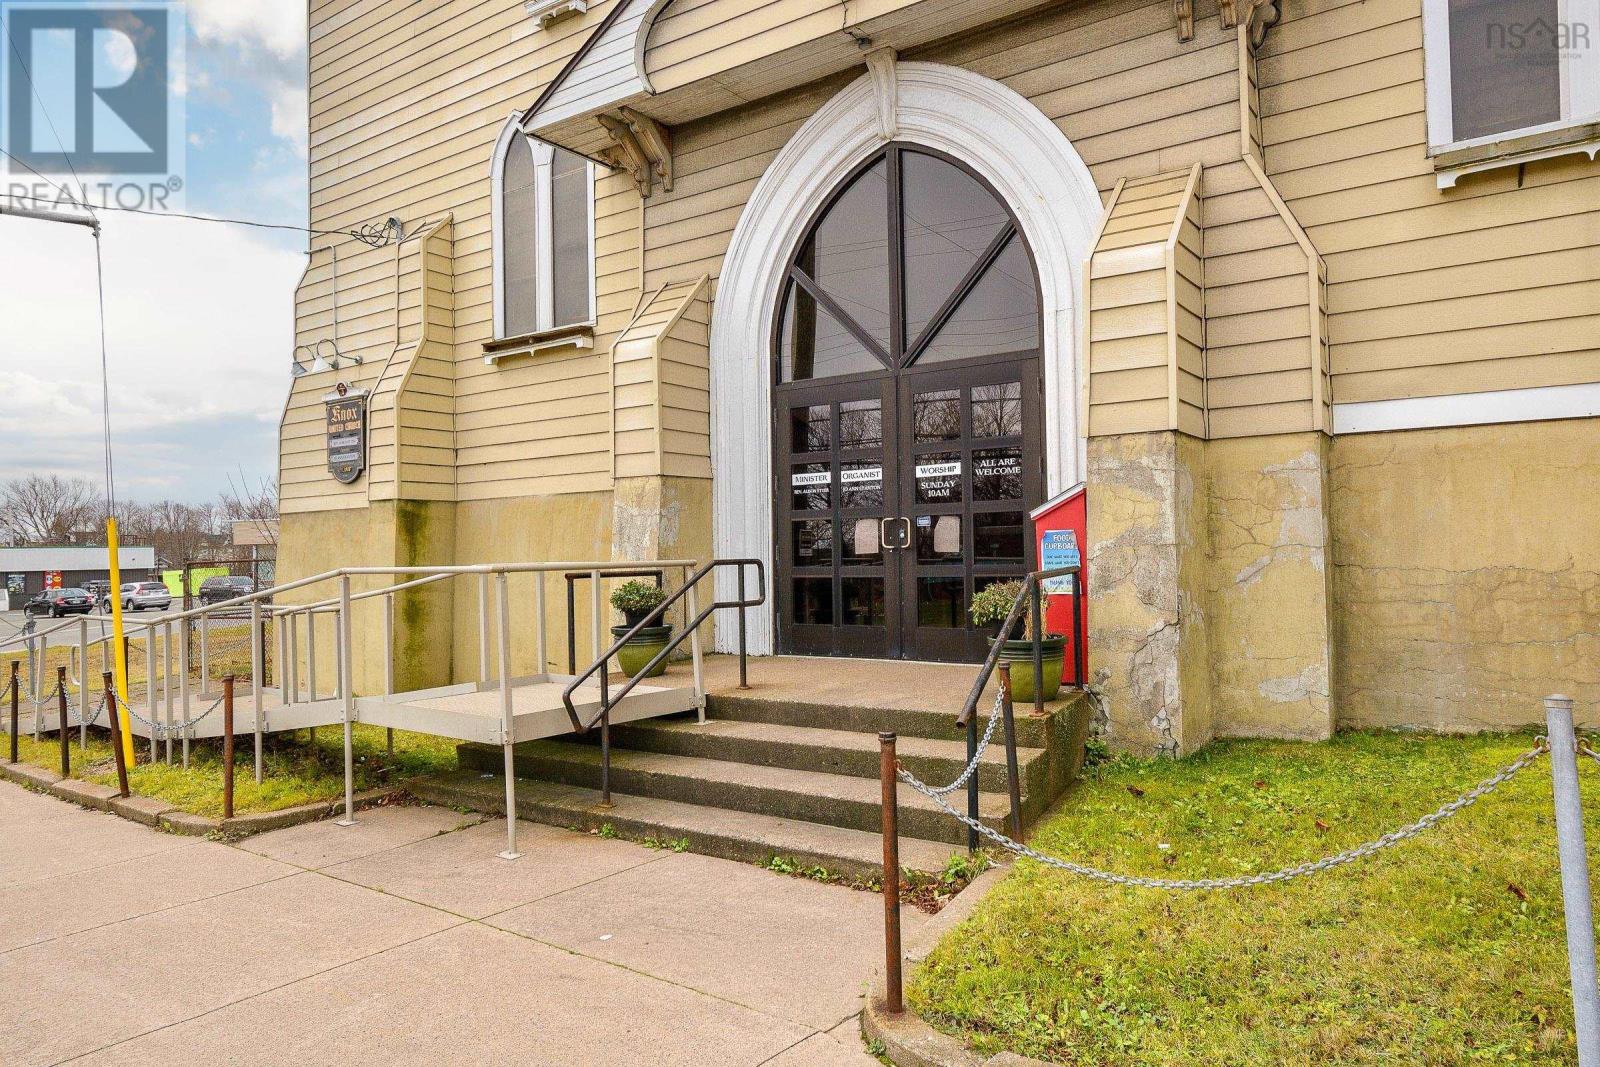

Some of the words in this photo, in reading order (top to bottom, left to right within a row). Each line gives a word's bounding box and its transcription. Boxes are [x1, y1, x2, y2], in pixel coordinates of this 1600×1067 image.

[331, 405, 358, 423] Knox
[980, 459, 997, 468] ALL
[998, 458, 1017, 466] ARE
[920, 465, 957, 475] WORSHIP
[975, 466, 1022, 476] WELCOME
[795, 475, 828, 483] MINISTER
[842, 471, 881, 480] ORGANIST
[921, 480, 956, 489] SUNDAY
[928, 489, 950, 497] 10AM
